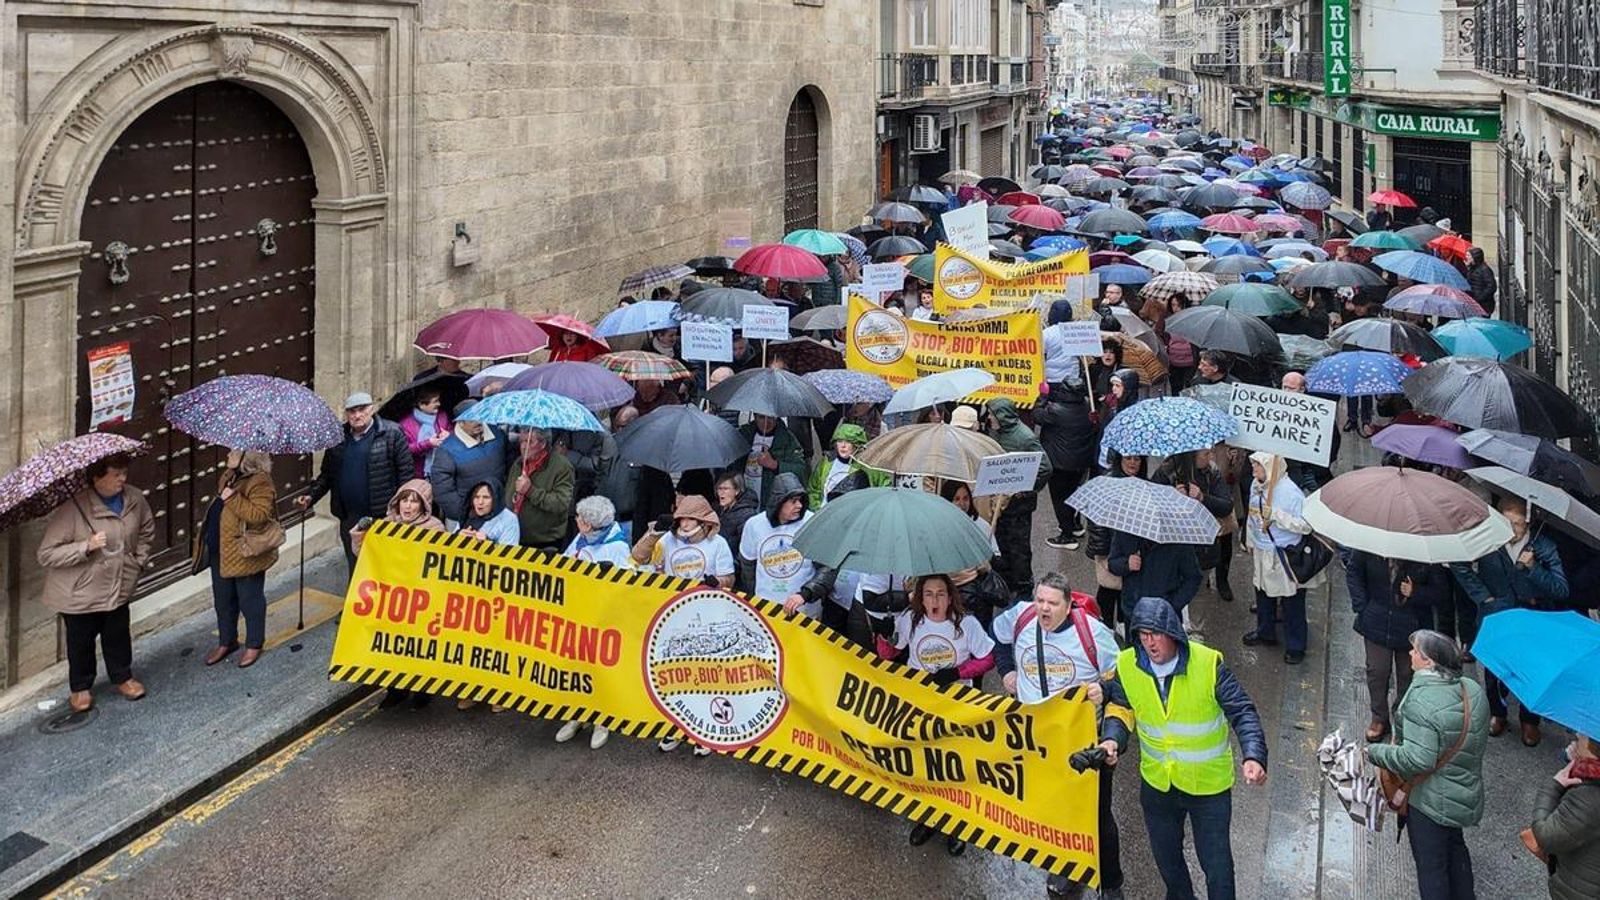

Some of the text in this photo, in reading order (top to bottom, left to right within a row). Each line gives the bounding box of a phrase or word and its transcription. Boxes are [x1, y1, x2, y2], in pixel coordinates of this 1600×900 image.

[1329, 5, 1347, 93] RURAL
[1378, 113, 1480, 135] CAJA RURAL
[912, 332, 946, 351] STOP
[950, 359, 960, 369] LA
[998, 359, 1032, 371] ALDEAS
[1004, 373, 1016, 384] NO
[1233, 405, 1320, 430] DE RESPIRAR
[1243, 420, 1265, 434] TU
[986, 458, 1011, 467] SALUD
[1000, 467, 1017, 475] QUE
[422, 551, 565, 605] PLATAFORMA
[353, 580, 430, 624] STOP
[443, 641, 464, 665] LA
[470, 646, 510, 675] REAL
[517, 656, 527, 678] Y
[530, 661, 593, 694] ALDEAS
[658, 667, 691, 686] STOP
[706, 723, 716, 734] LA
[720, 726, 740, 735] REAL
[741, 724, 747, 732] Y
[748, 697, 775, 729] ALDEAS
[841, 730, 1024, 801] PERO NO ASÍ
[792, 728, 814, 749] POR
[817, 736, 832, 754] UN
[975, 795, 982, 814] Y
[985, 800, 1095, 855] AUTOSUFICIENCIA
